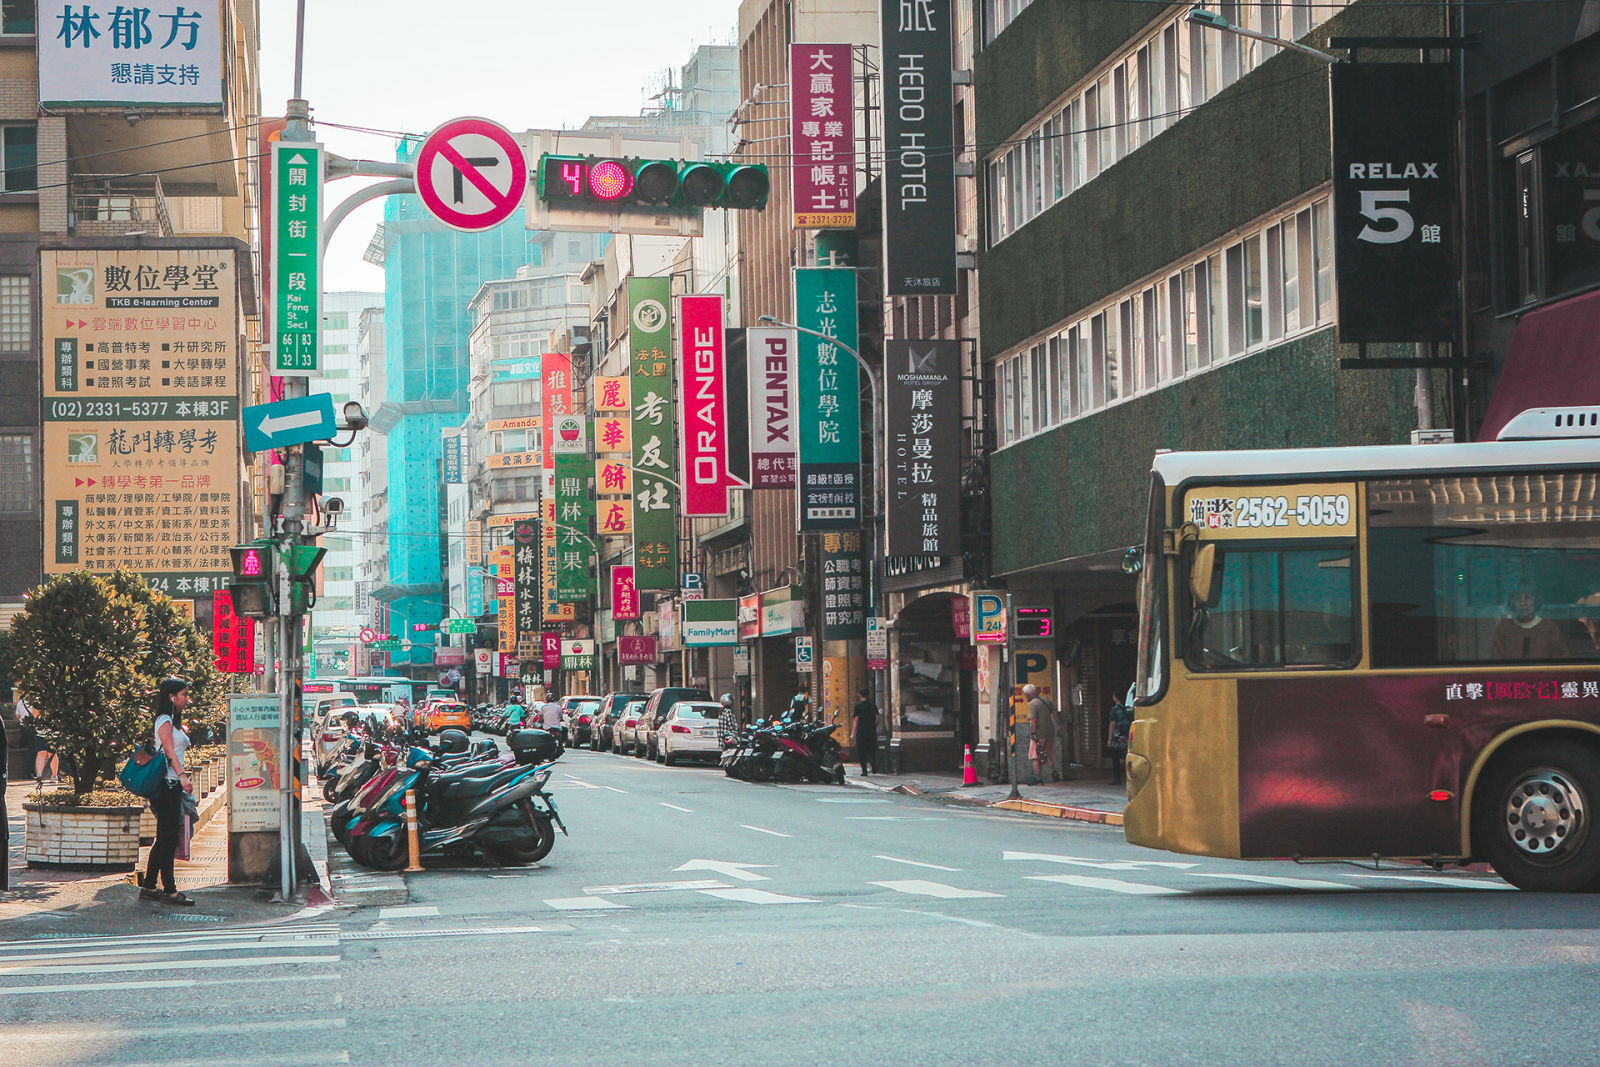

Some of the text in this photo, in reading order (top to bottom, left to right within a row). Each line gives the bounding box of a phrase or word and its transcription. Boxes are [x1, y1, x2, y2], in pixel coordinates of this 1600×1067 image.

[56, 5, 204, 51] 林郁方
[111, 63, 200, 86] 懇請支持
[809, 49, 835, 118] 大贏家
[801, 120, 844, 137] 專業
[898, 54, 927, 211] HEDO HOTEL
[564, 163, 581, 195] 4
[810, 140, 836, 209] 記帳士
[1349, 162, 1439, 179] RELAX
[1357, 188, 1415, 244] 5
[287, 167, 308, 291] 開封街一段
[1420, 224, 1441, 243] 館
[104, 264, 219, 292] 數位學堂
[111, 299, 213, 308] TKB e-learning Center
[287, 294, 302, 302] Kai
[287, 303, 309, 313] Feng
[287, 312, 298, 320] St
[92, 317, 217, 331] 雲端數位學習中心
[97, 341, 151, 354] 高普特考
[173, 341, 227, 354] 升研究所
[282, 333, 293, 345] 66
[301, 333, 312, 345] 83
[61, 341, 73, 389] 專辦類科
[97, 359, 151, 371] 國營事業
[173, 358, 227, 371] 大學轉學
[282, 354, 293, 366] 32
[301, 354, 312, 366] 33
[815, 290, 841, 444] 志光數位學院
[97, 376, 151, 389] 證照考試
[173, 375, 227, 388] 美語課程
[897, 374, 949, 382] MOSHAMANLA
[764, 337, 789, 444] PENTAX
[52, 401, 229, 418] (02)2331-5377 本棟3F
[694, 326, 718, 484] ORANGE
[503, 419, 537, 429] Amando
[105, 427, 218, 455] 龍門轉學考
[911, 389, 934, 484] 摩莎曼拉
[68, 454, 98, 464] TKB
[600, 380, 628, 533] 麗華餅店
[635, 391, 671, 513] 考友社
[757, 458, 797, 471] 總代理
[897, 433, 907, 500] HOTEL
[101, 474, 211, 489] 轉學考第一品牌
[1235, 495, 1350, 528] 2562-5059
[561, 477, 583, 571] 鼎林水果
[920, 492, 939, 552] 精品旅館
[61, 505, 74, 557] 專辦類科
[824, 532, 860, 554] 專辦
[175, 576, 230, 593] 本棟1F
[517, 546, 536, 630] 梅林水果行
[685, 574, 700, 589] P
[825, 610, 864, 626] 研究所
[976, 594, 1003, 631] P
[687, 627, 736, 638] FamilyMart
[1040, 618, 1051, 636] 3
[546, 639, 556, 650] R
[564, 655, 592, 670] 鼎林
[1015, 653, 1047, 685] P
